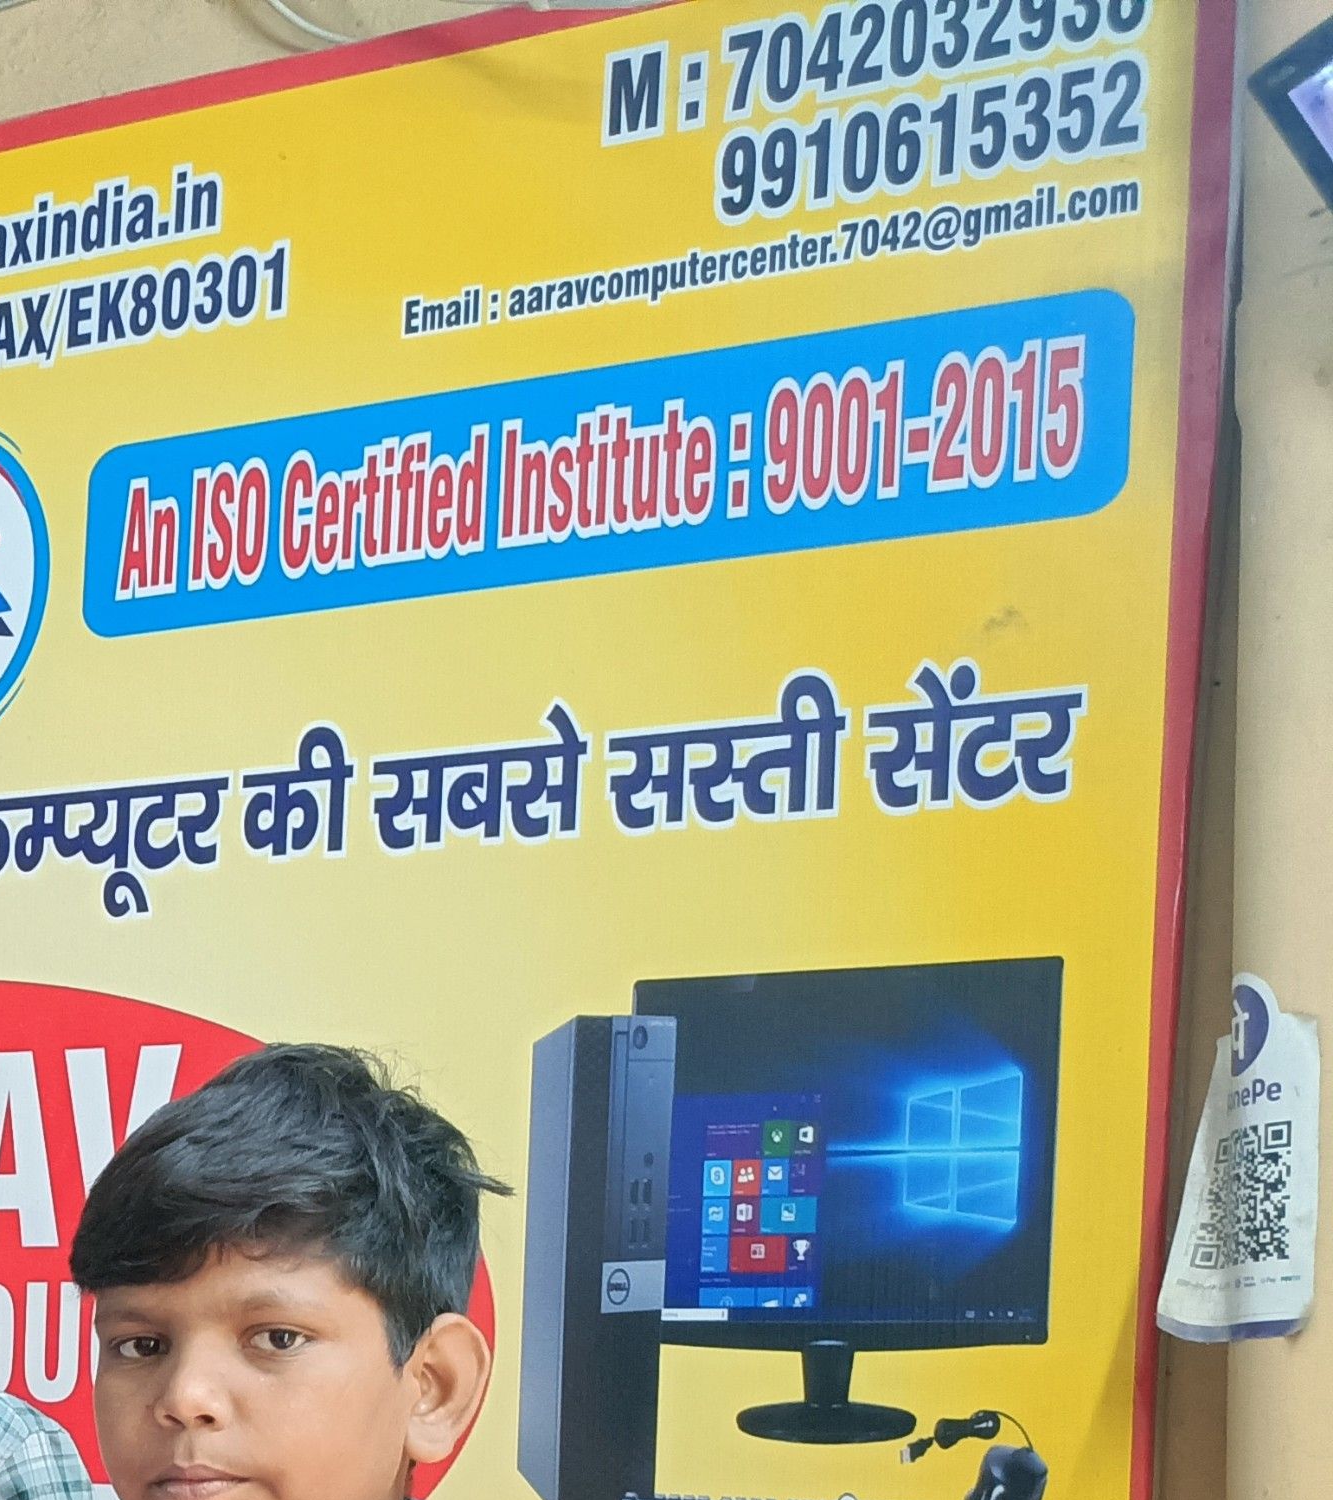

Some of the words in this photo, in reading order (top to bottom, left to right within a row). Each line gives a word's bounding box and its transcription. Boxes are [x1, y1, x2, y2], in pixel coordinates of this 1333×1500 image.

[608, 51, 661, 137] M
[720, 60, 1141, 216] 9910615352
[404, 288, 480, 336] Email
[508, 181, 1140, 317] aaravcomputercenter.7042@gmail.com
[121, 479, 177, 596] An
[191, 457, 261, 588] ISO
[283, 426, 479, 576] Certified
[502, 406, 713, 547] Institute
[765, 344, 1083, 510] 9001-2015
[242, 725, 353, 856] की
[371, 700, 589, 849] सबसे
[607, 669, 846, 828] सस्ती
[866, 660, 1083, 811] सेंटर
